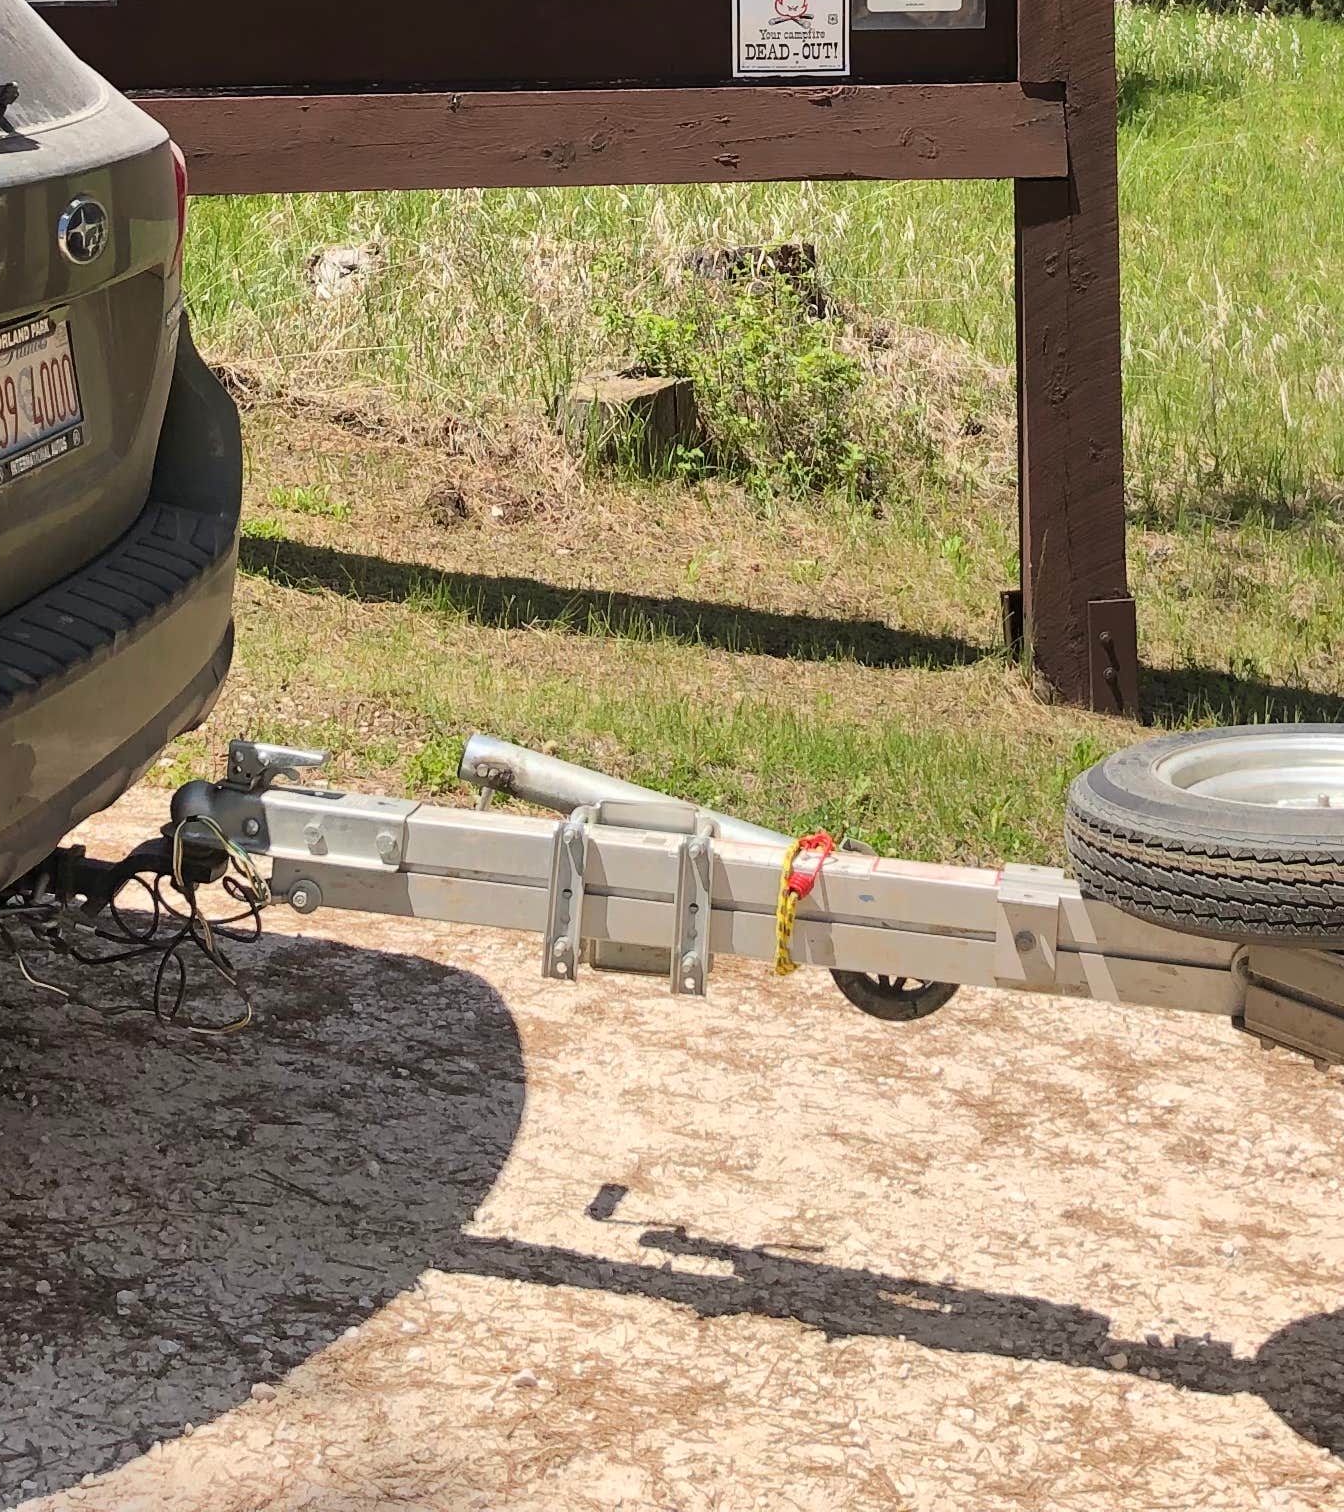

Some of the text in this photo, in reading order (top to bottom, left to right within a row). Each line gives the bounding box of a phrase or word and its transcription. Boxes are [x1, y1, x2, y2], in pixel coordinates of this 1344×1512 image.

[759, 28, 826, 41] Your campfire
[744, 42, 838, 60] DEAD OUT!
[30, 317, 51, 340] PARK
[29, 353, 78, 431] 4000
